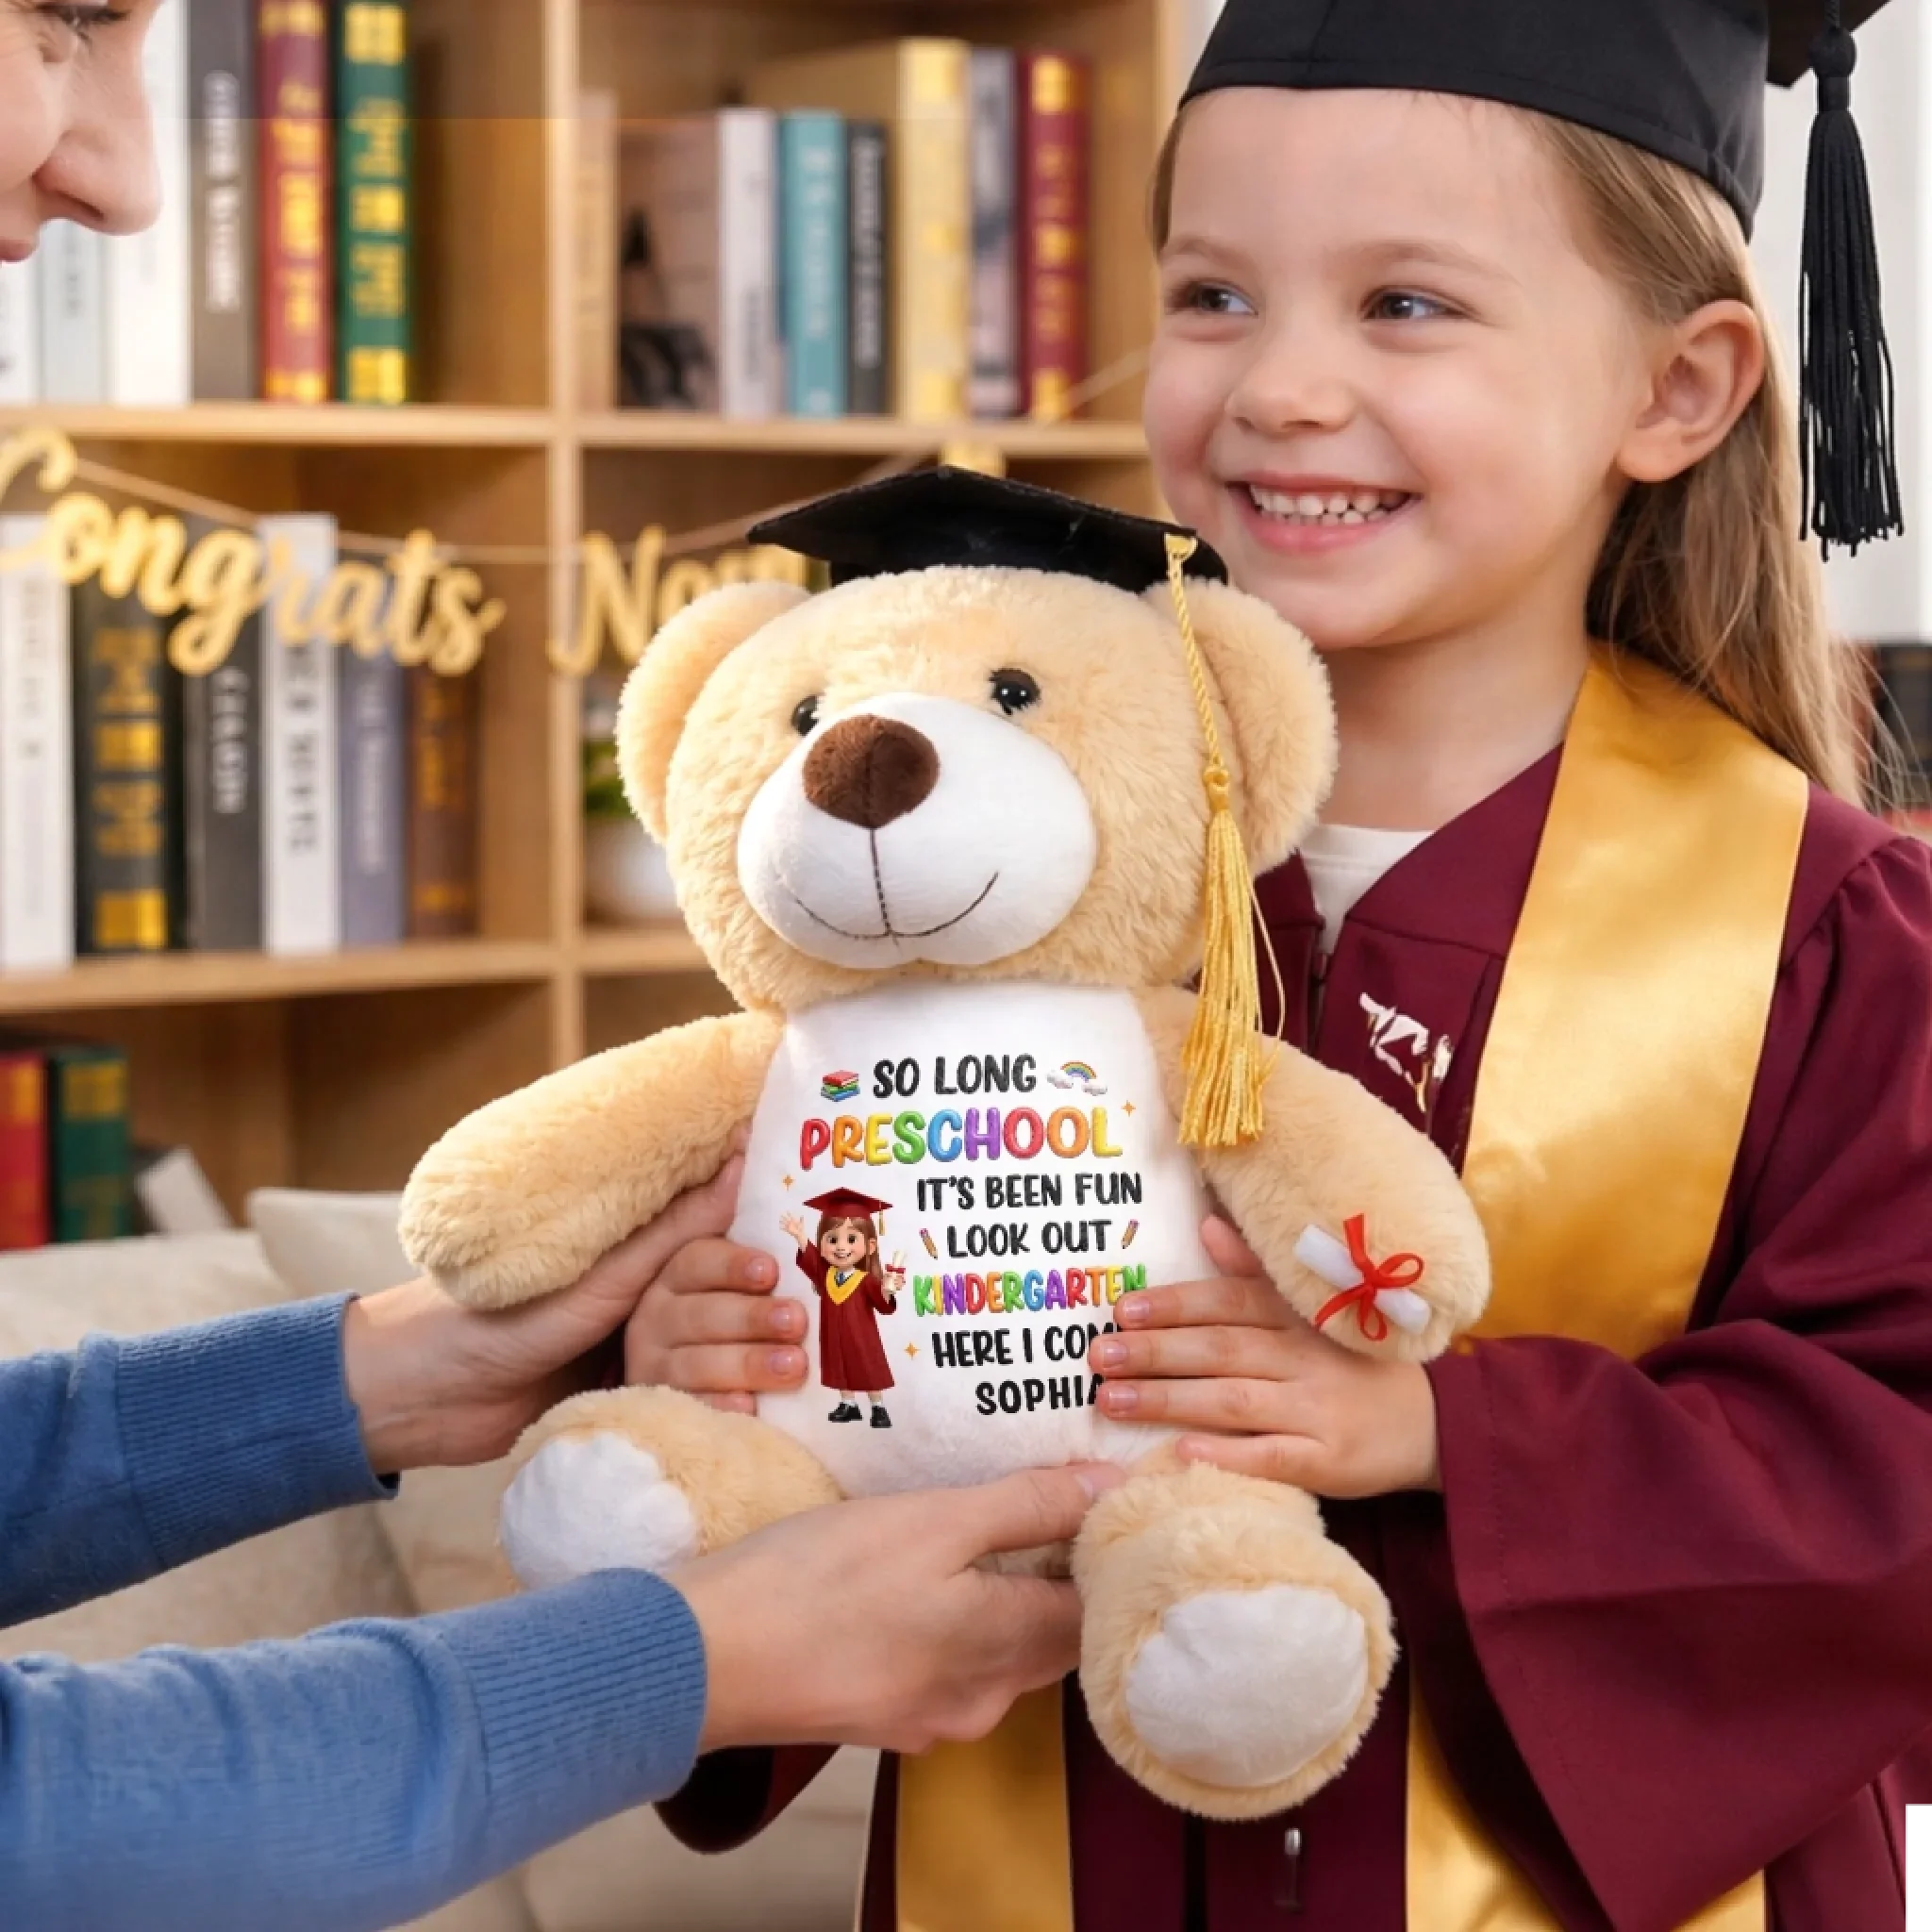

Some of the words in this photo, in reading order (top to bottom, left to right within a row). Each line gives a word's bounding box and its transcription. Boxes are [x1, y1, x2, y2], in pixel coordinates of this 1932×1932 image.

[0, 426, 506, 675] Congrats
[873, 1058, 921, 1098] SO
[935, 1053, 1037, 1095] LONG
[800, 1107, 1124, 1172] PRESCHOOL
[917, 1175, 974, 1211] IT'S
[985, 1173, 1062, 1209] BEEN
[1074, 1172, 1142, 1206] FUN
[946, 1223, 1030, 1258] LOOK
[1041, 1219, 1112, 1254] OUT
[931, 1328, 1013, 1368] HERE
[1022, 1327, 1033, 1363] I
